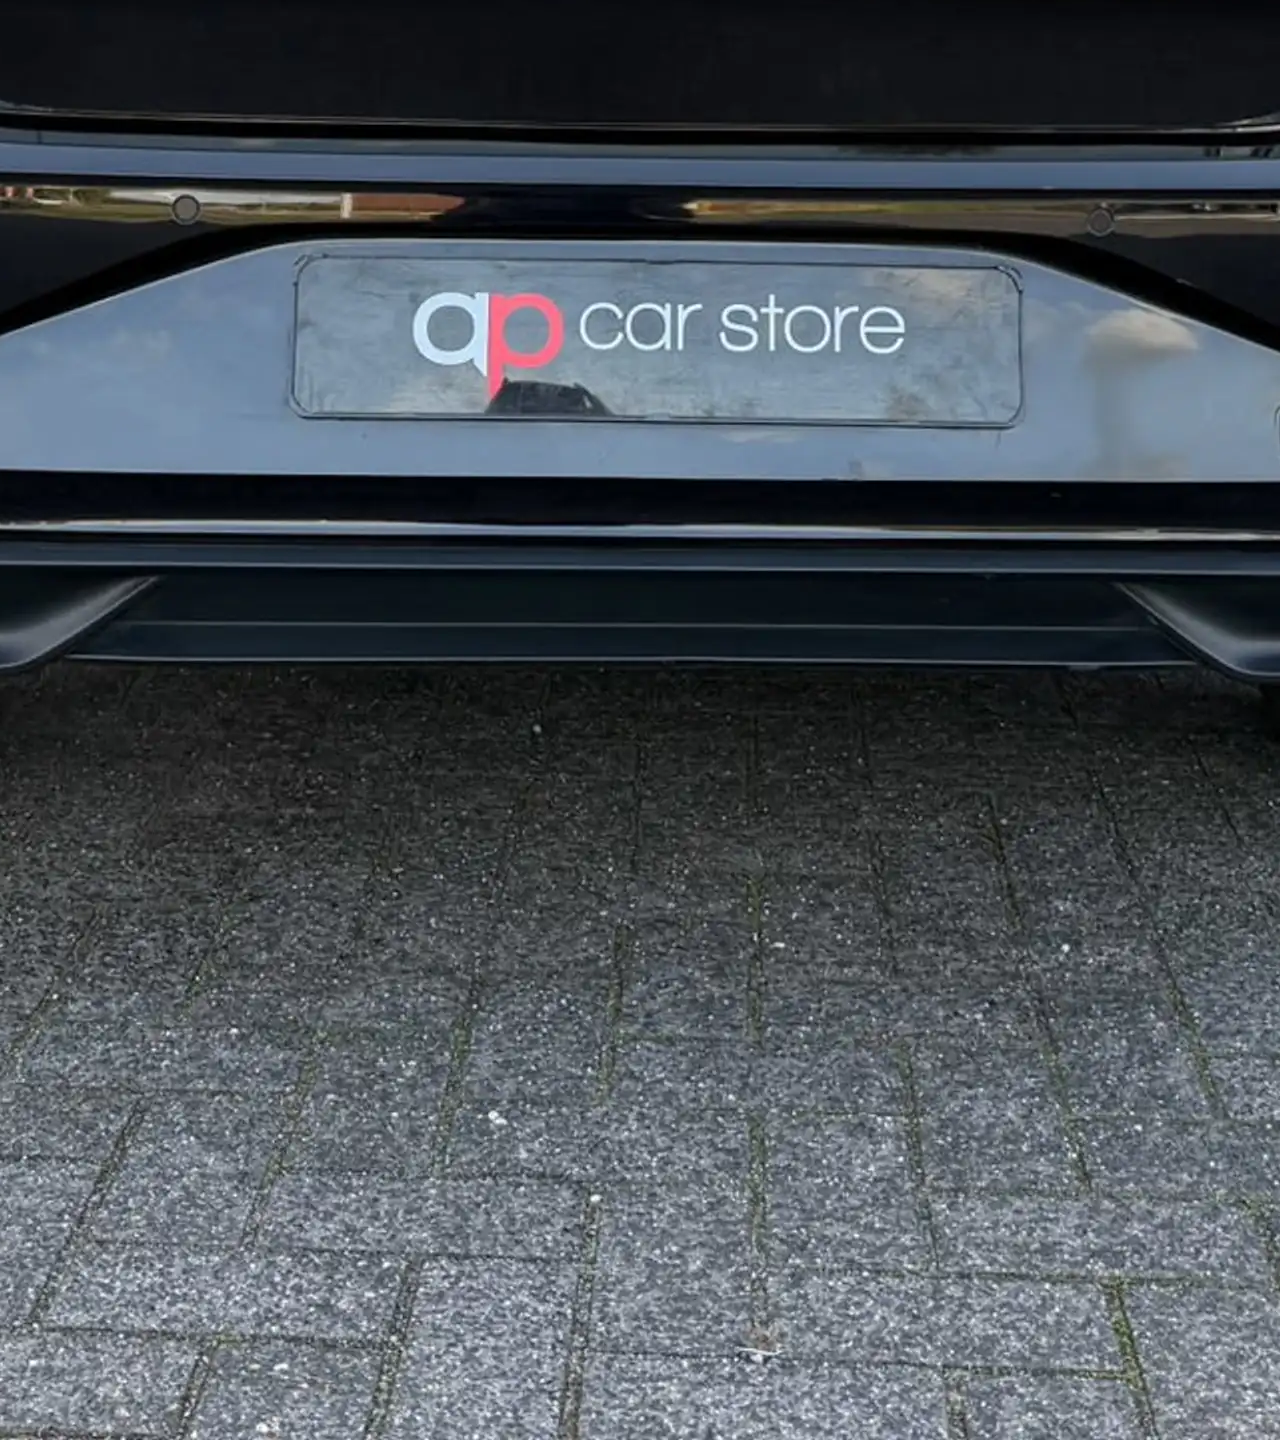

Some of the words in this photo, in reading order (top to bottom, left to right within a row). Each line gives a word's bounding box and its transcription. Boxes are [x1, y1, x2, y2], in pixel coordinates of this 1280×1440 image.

[412, 292, 565, 399] ap
[579, 301, 703, 353] car
[719, 294, 906, 355] store
